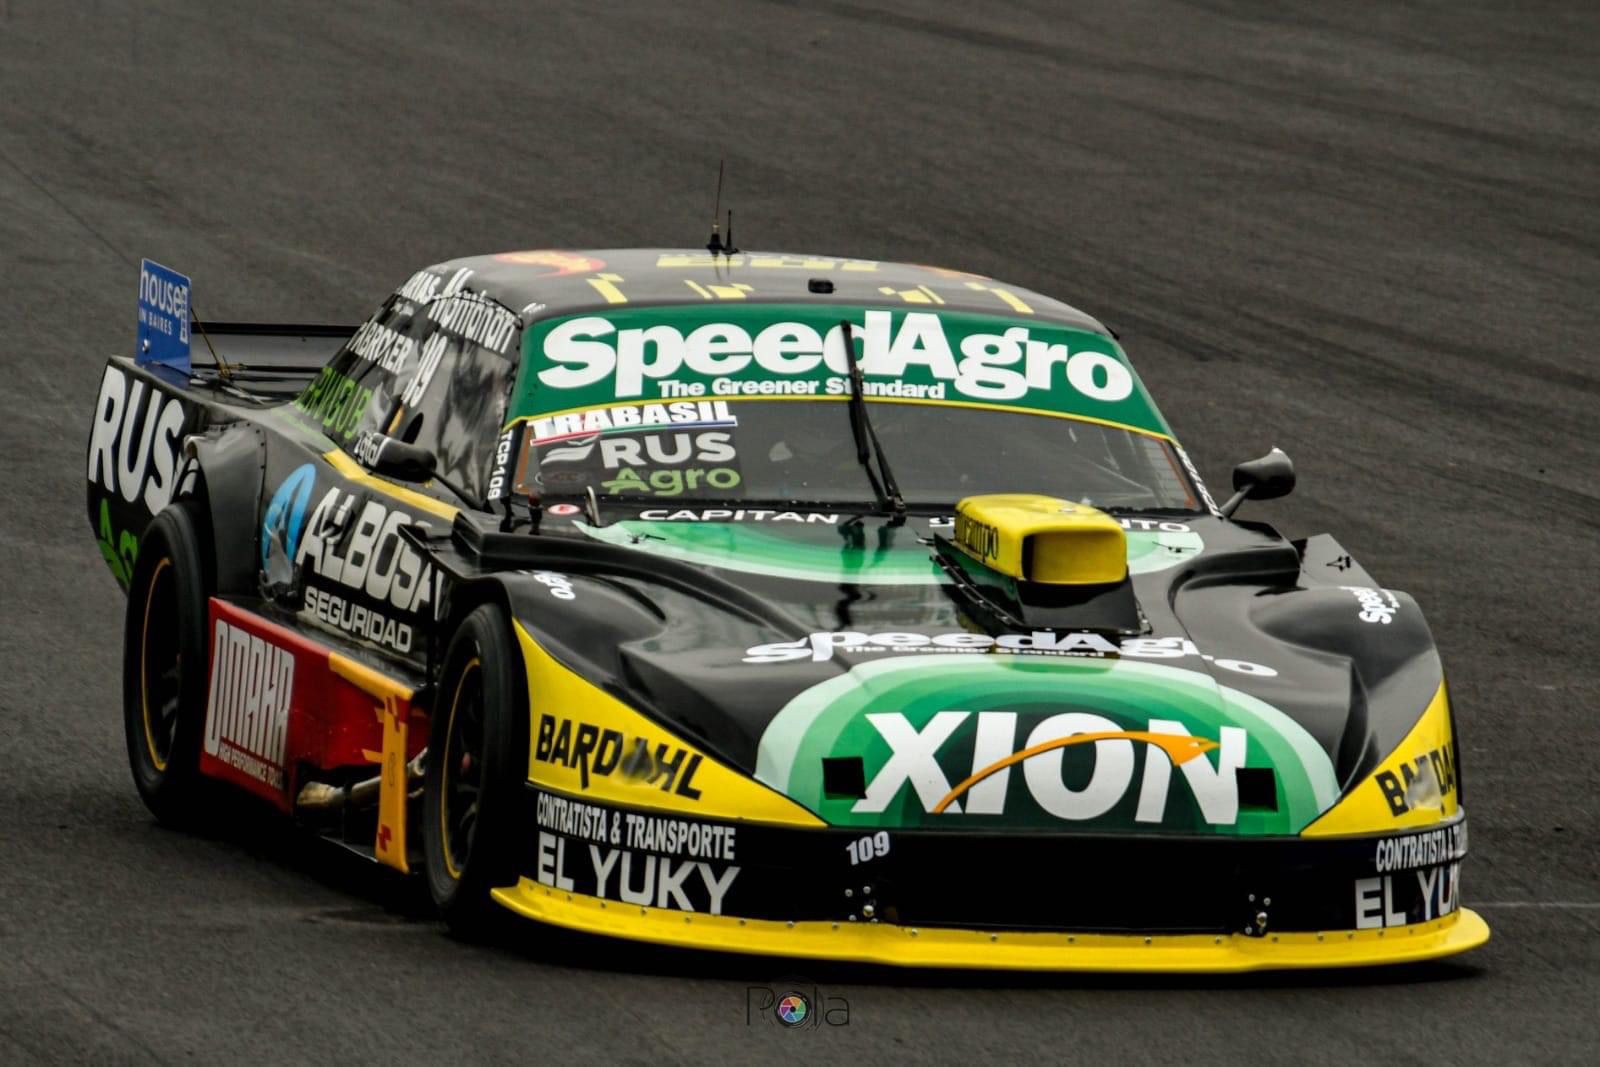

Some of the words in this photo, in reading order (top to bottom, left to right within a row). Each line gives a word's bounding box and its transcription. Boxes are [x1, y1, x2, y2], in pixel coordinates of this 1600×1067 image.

[537, 310, 1133, 402] SpeedAgro
[658, 380, 705, 397] The
[711, 377, 819, 395] Greener
[88, 365, 185, 517] RUS
[528, 400, 737, 438] TRABASIL
[600, 432, 736, 469] RUS
[602, 467, 741, 496] Agro
[639, 509, 840, 525] CAPITAN
[304, 586, 412, 653] SEGURIDAD
[851, 711, 1247, 825] XION
[536, 792, 607, 843] CONTRATISTA
[610, 811, 621, 844] &
[626, 813, 736, 860] TRANSPORTE
[845, 831, 890, 865] 109
[536, 831, 574, 892] EL
[588, 844, 741, 915] YUKY
[1376, 830, 1446, 873] CONTRATISTA
[1355, 875, 1407, 930] EL
